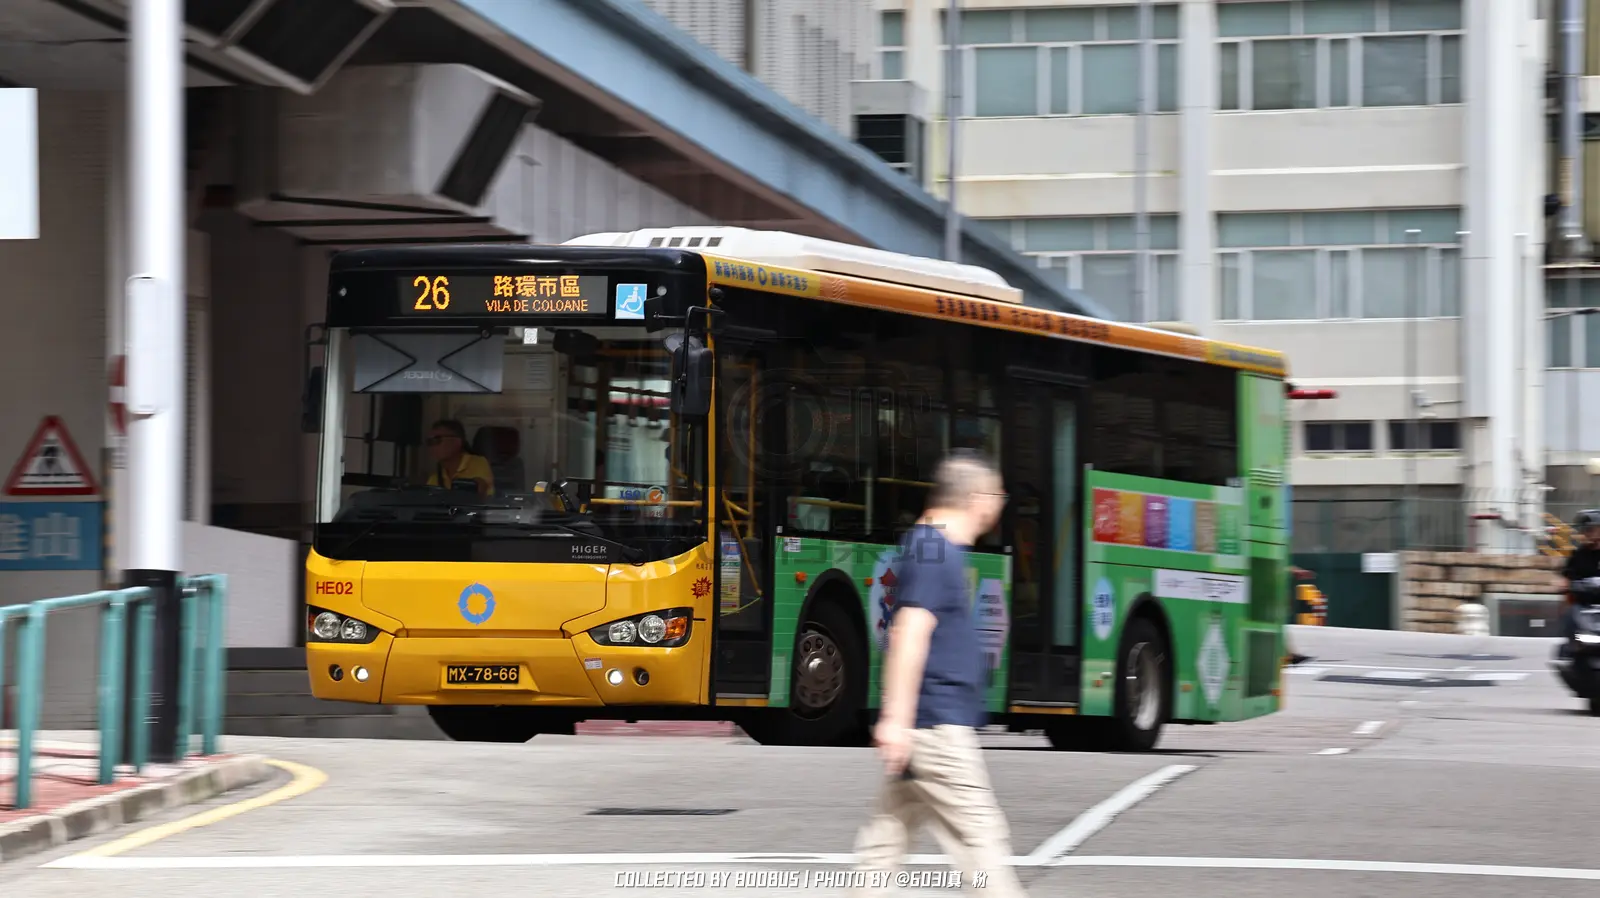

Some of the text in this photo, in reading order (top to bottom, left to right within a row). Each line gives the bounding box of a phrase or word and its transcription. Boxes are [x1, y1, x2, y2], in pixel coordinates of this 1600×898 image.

[413, 275, 450, 311] 26
[493, 274, 581, 298] 路環市區
[485, 299, 588, 313] VILA DE COLOANE
[571, 545, 607, 554] HIGER
[316, 581, 353, 595] HE02
[449, 667, 517, 681] MX-78-66
